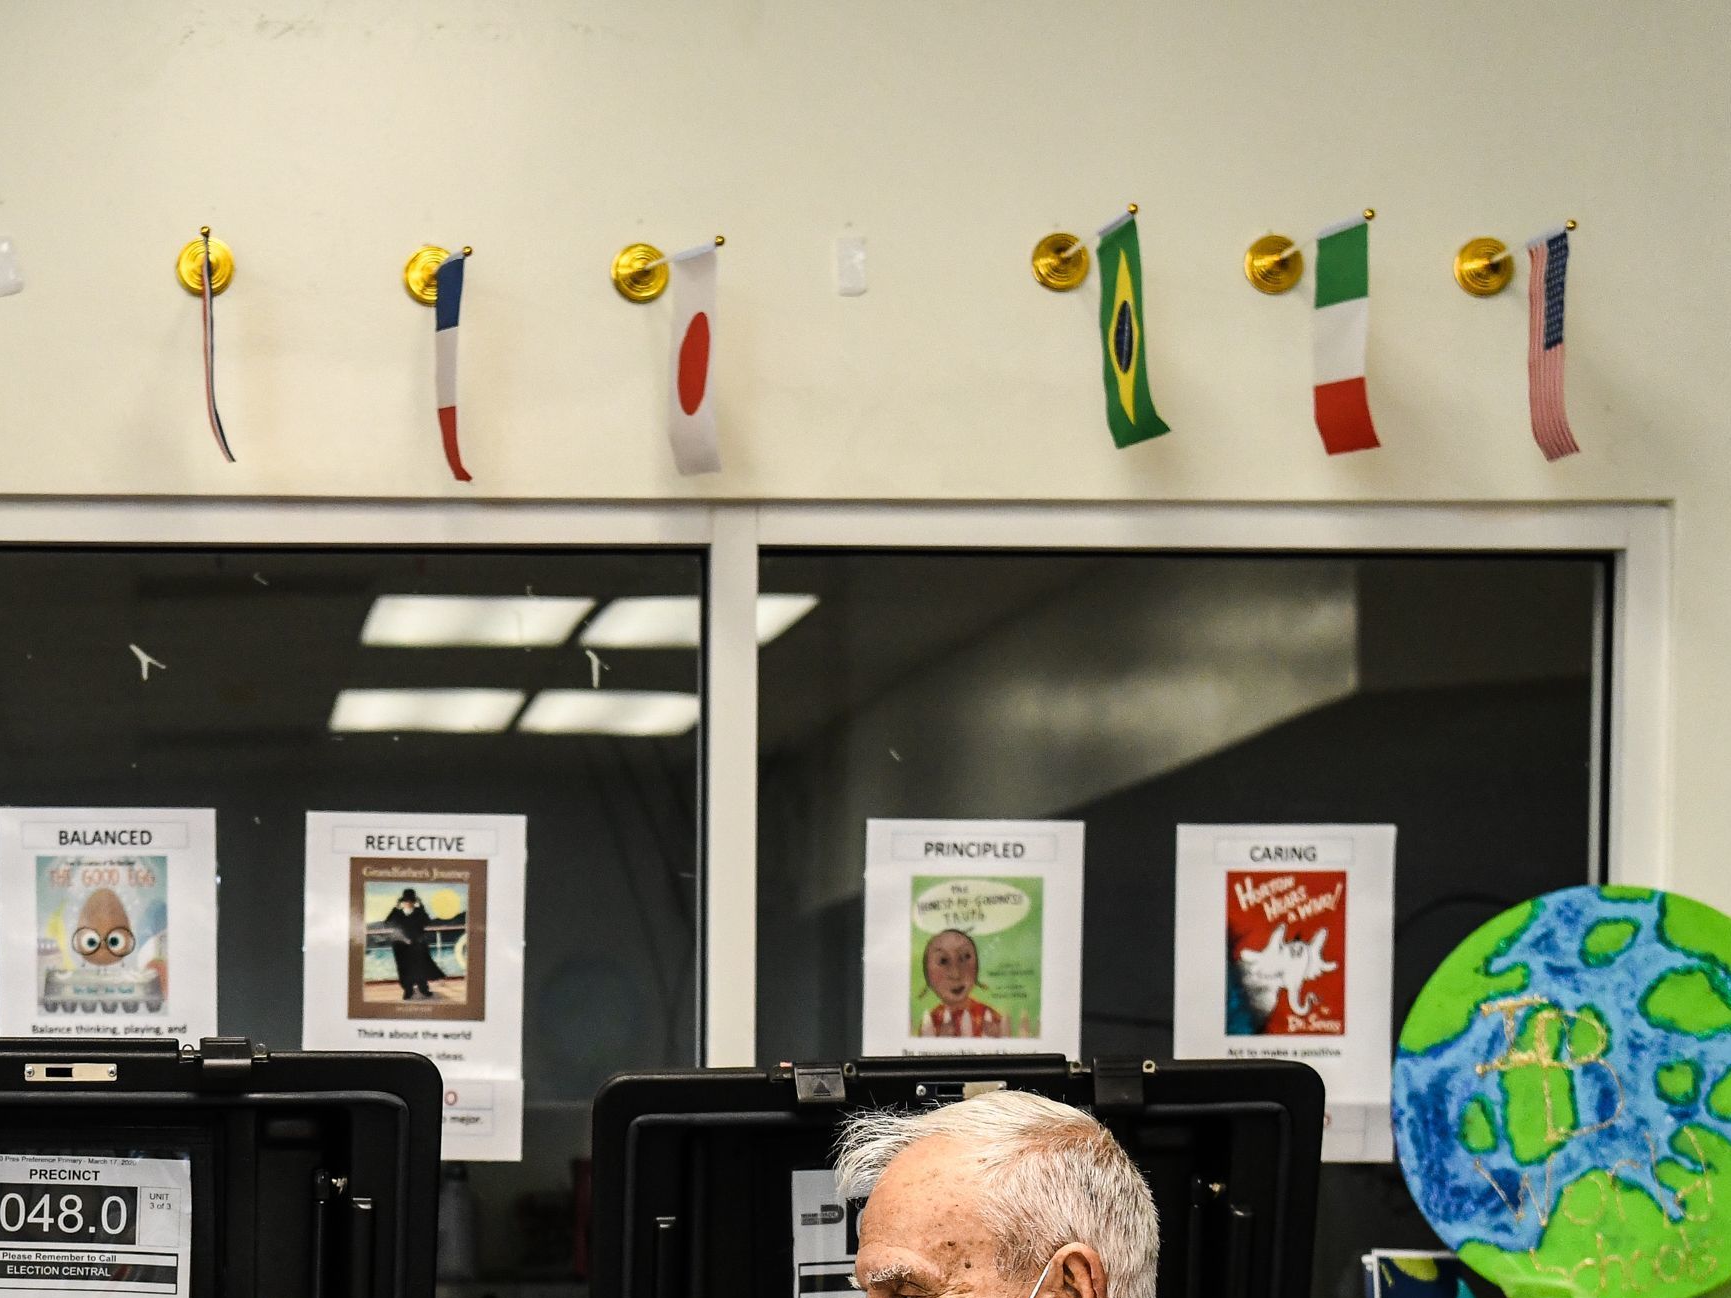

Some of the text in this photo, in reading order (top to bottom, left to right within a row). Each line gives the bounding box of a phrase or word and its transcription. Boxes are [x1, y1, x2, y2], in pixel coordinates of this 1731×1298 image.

[58, 830, 153, 846] BALANCED
[364, 834, 466, 852] REFLECTIVE
[924, 842, 1026, 859] PRINCIPLED
[1249, 846, 1318, 863] CARING
[31, 1025, 71, 1034] Balance
[75, 1025, 121, 1036] thinking,
[167, 1025, 187, 1034] and
[357, 1029, 472, 1041] Think about the world
[28, 1168, 101, 1182] PRECINCT
[149, 1192, 170, 1201] UNIT
[0, 1192, 128, 1235] 048.0
[149, 1202, 172, 1211] 3 of 3
[1, 1251, 117, 1263] Please Remember to Call
[6, 1264, 112, 1278] ELECTION CENTRAL
